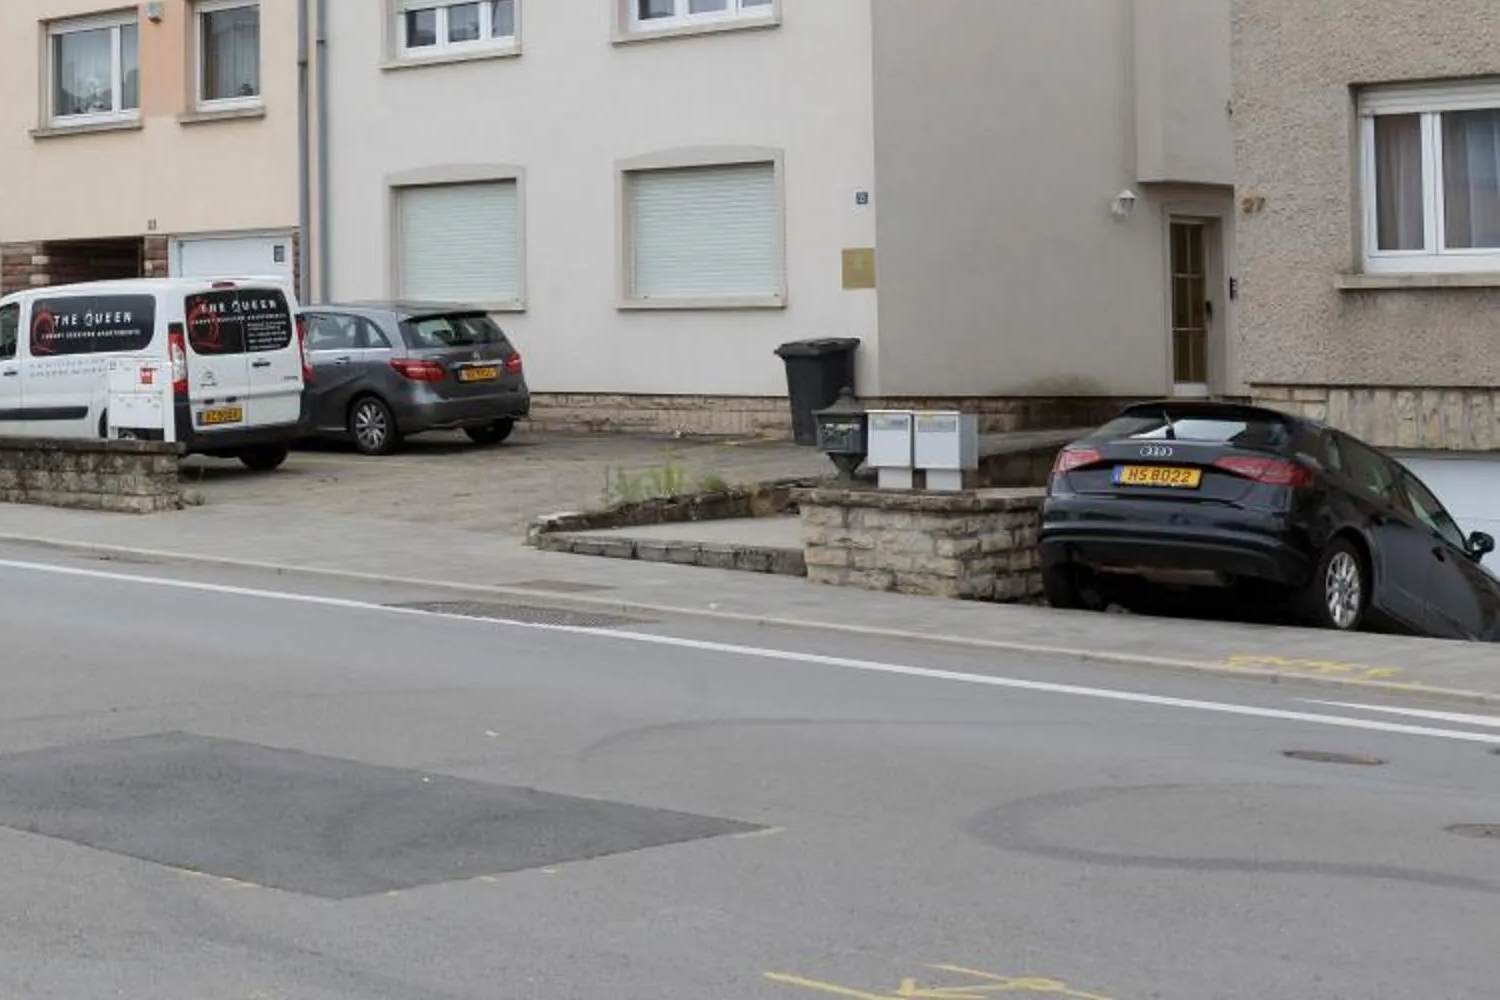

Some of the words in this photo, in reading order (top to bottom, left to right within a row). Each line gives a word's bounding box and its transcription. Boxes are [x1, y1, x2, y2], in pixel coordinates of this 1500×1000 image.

[54, 313, 78, 326] THE
[85, 310, 132, 326] QUEEN
[1128, 467, 1147, 481] HS
[1151, 469, 1192, 483] 8022
